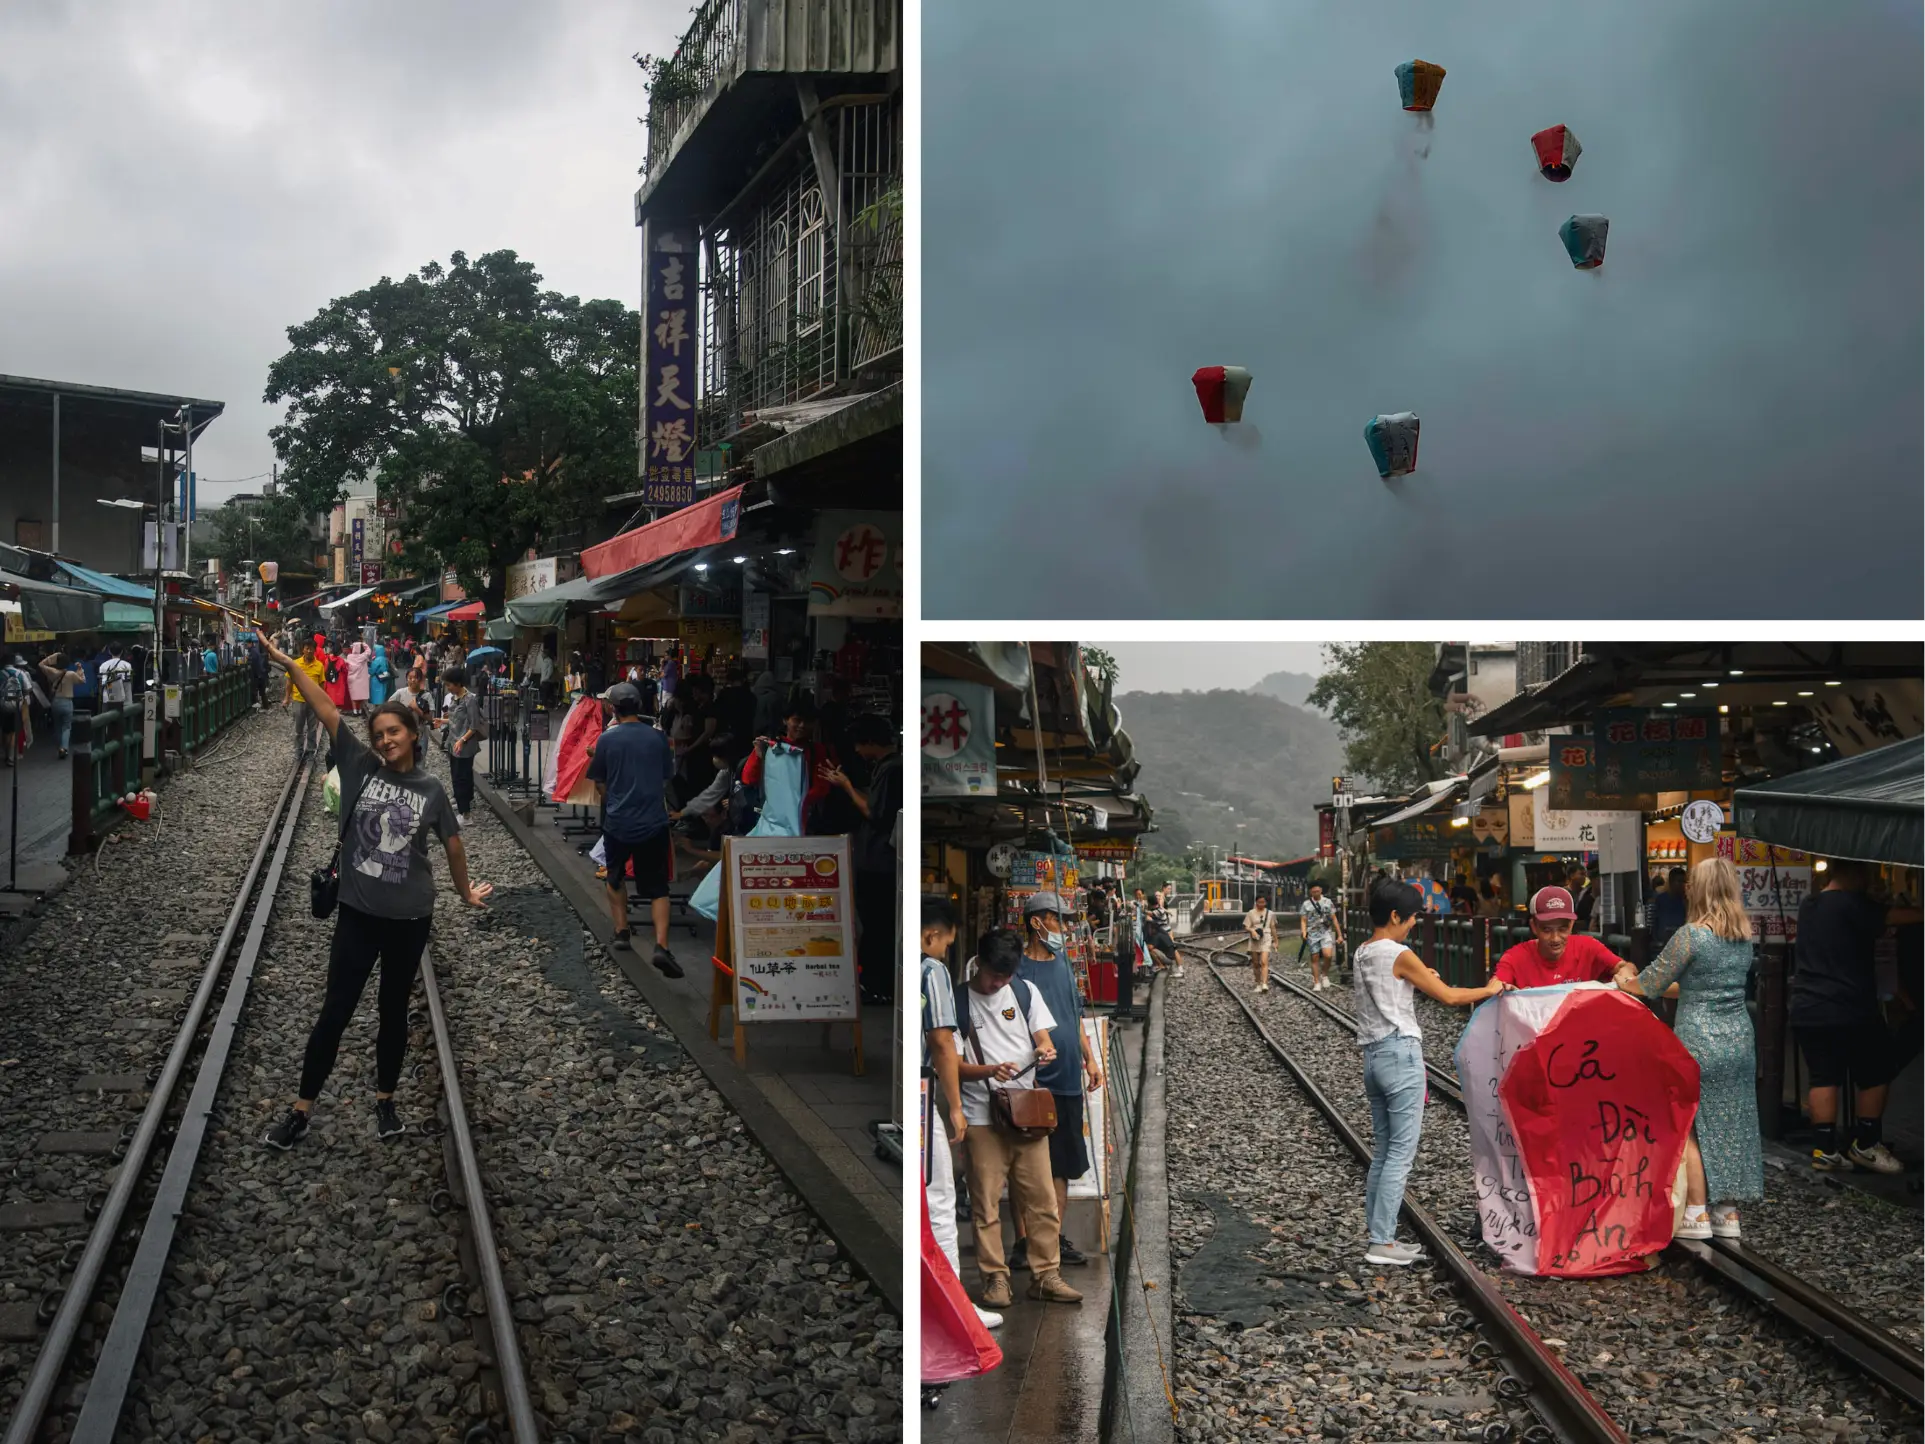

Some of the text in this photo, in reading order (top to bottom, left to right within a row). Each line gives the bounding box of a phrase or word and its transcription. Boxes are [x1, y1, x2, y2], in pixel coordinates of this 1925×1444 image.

[651, 256, 693, 462] 吉祥天燈
[647, 485, 693, 503] 24958850
[837, 528, 885, 577] 炸
[749, 960, 797, 977] 仙草茶
[1575, 1211, 1632, 1251] An
